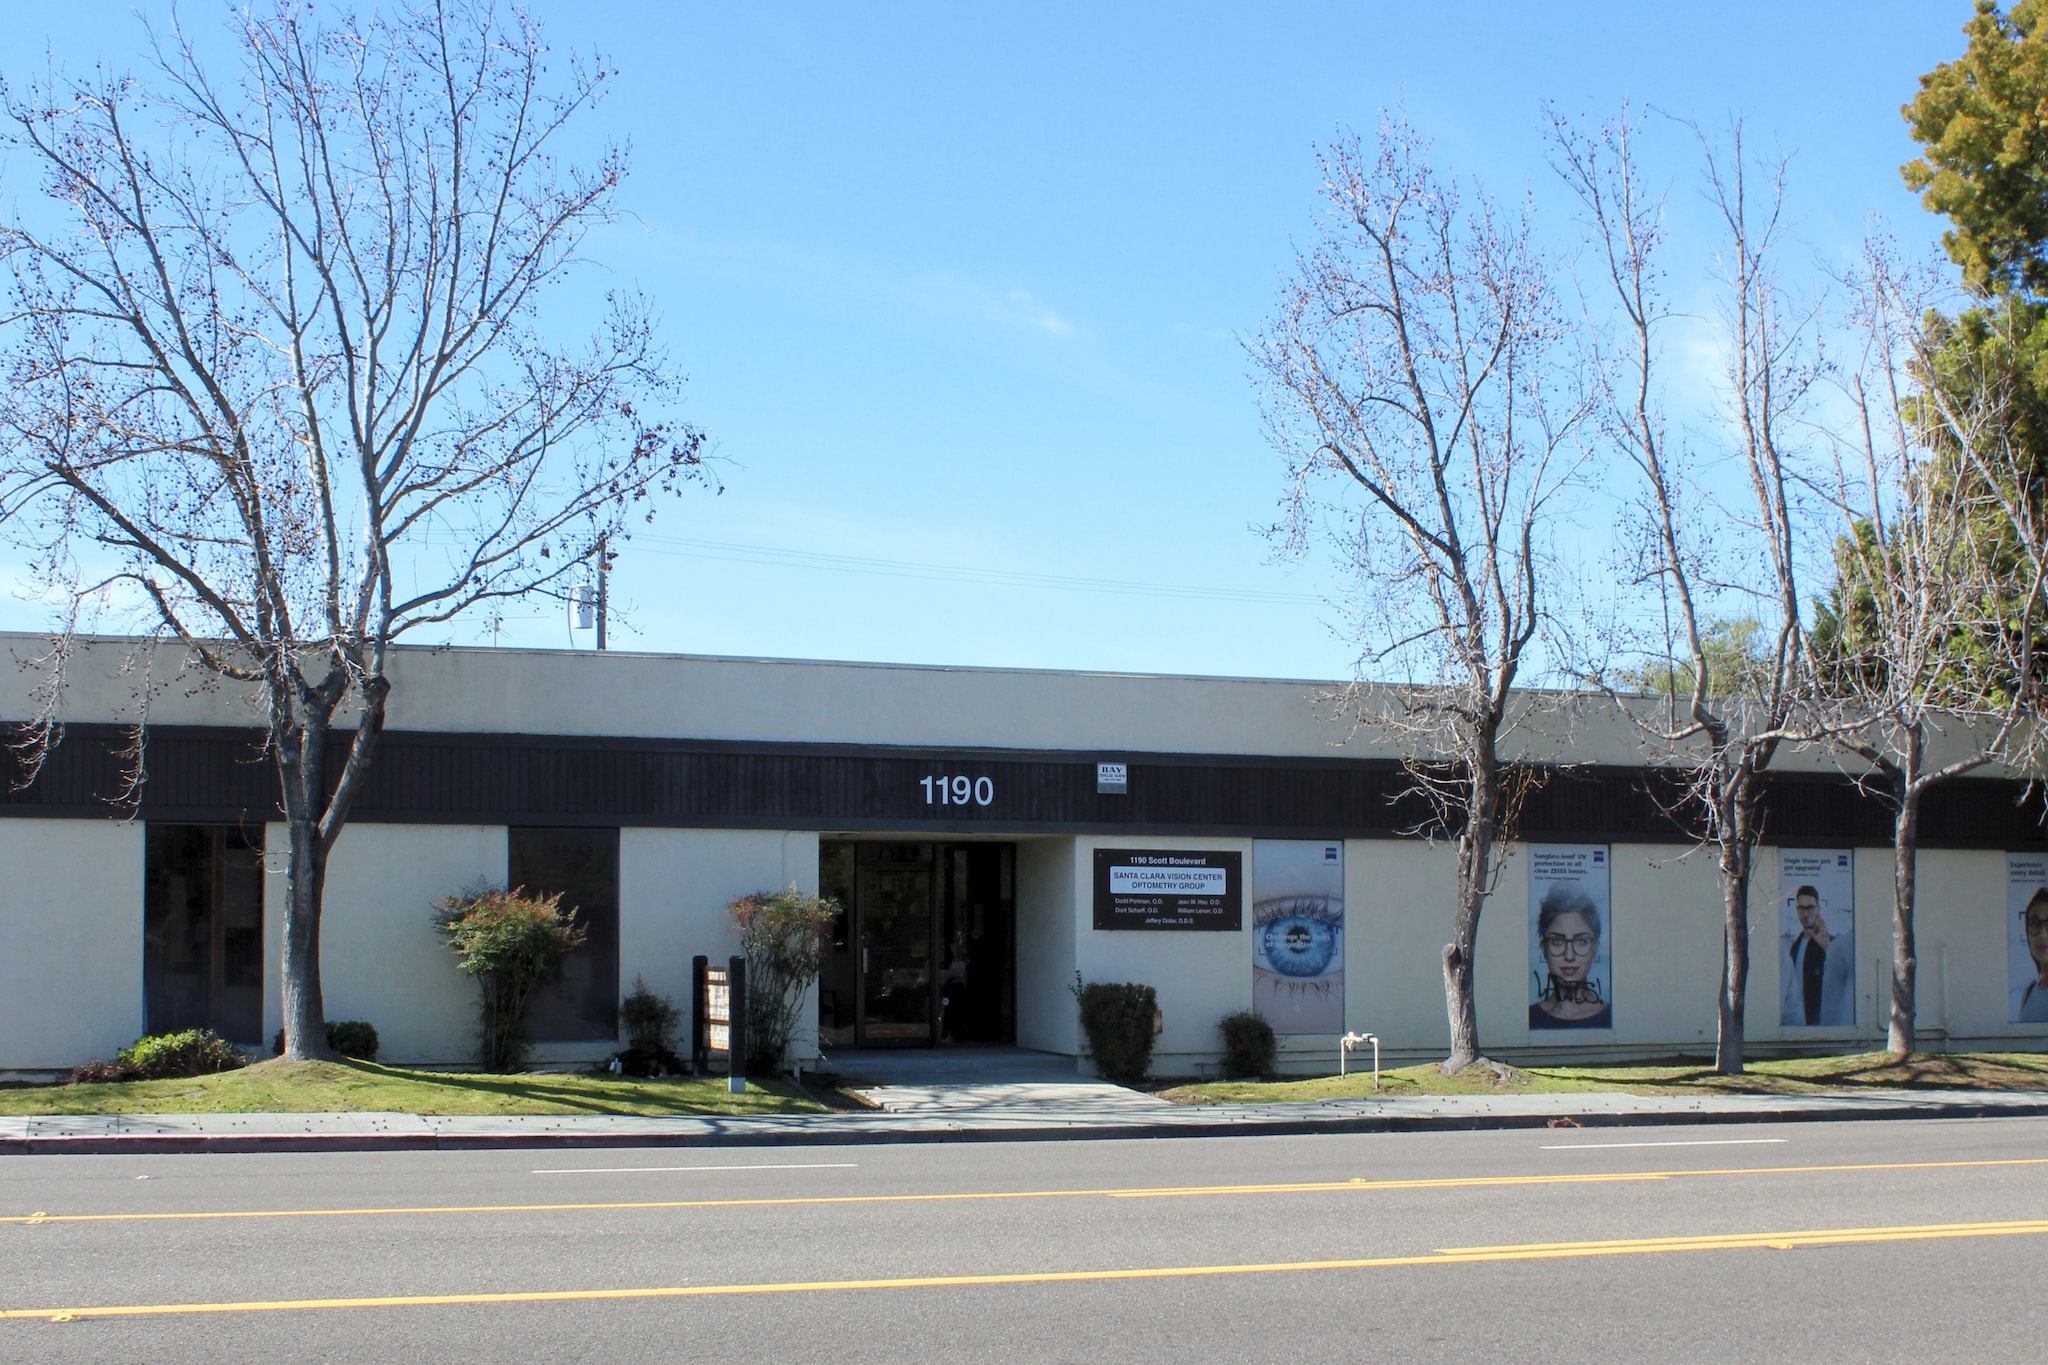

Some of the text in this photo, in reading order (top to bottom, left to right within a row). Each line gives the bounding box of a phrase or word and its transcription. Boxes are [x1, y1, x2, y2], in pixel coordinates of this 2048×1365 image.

[920, 776, 993, 806] 1190
[1130, 856, 1147, 864] 1190
[1168, 857, 1206, 865] Boulevard
[1114, 872, 1138, 880] SANTA
[1140, 872, 1165, 880] CLARA
[1193, 873, 1223, 881] CENTER
[1178, 882, 1205, 890] GROUP
